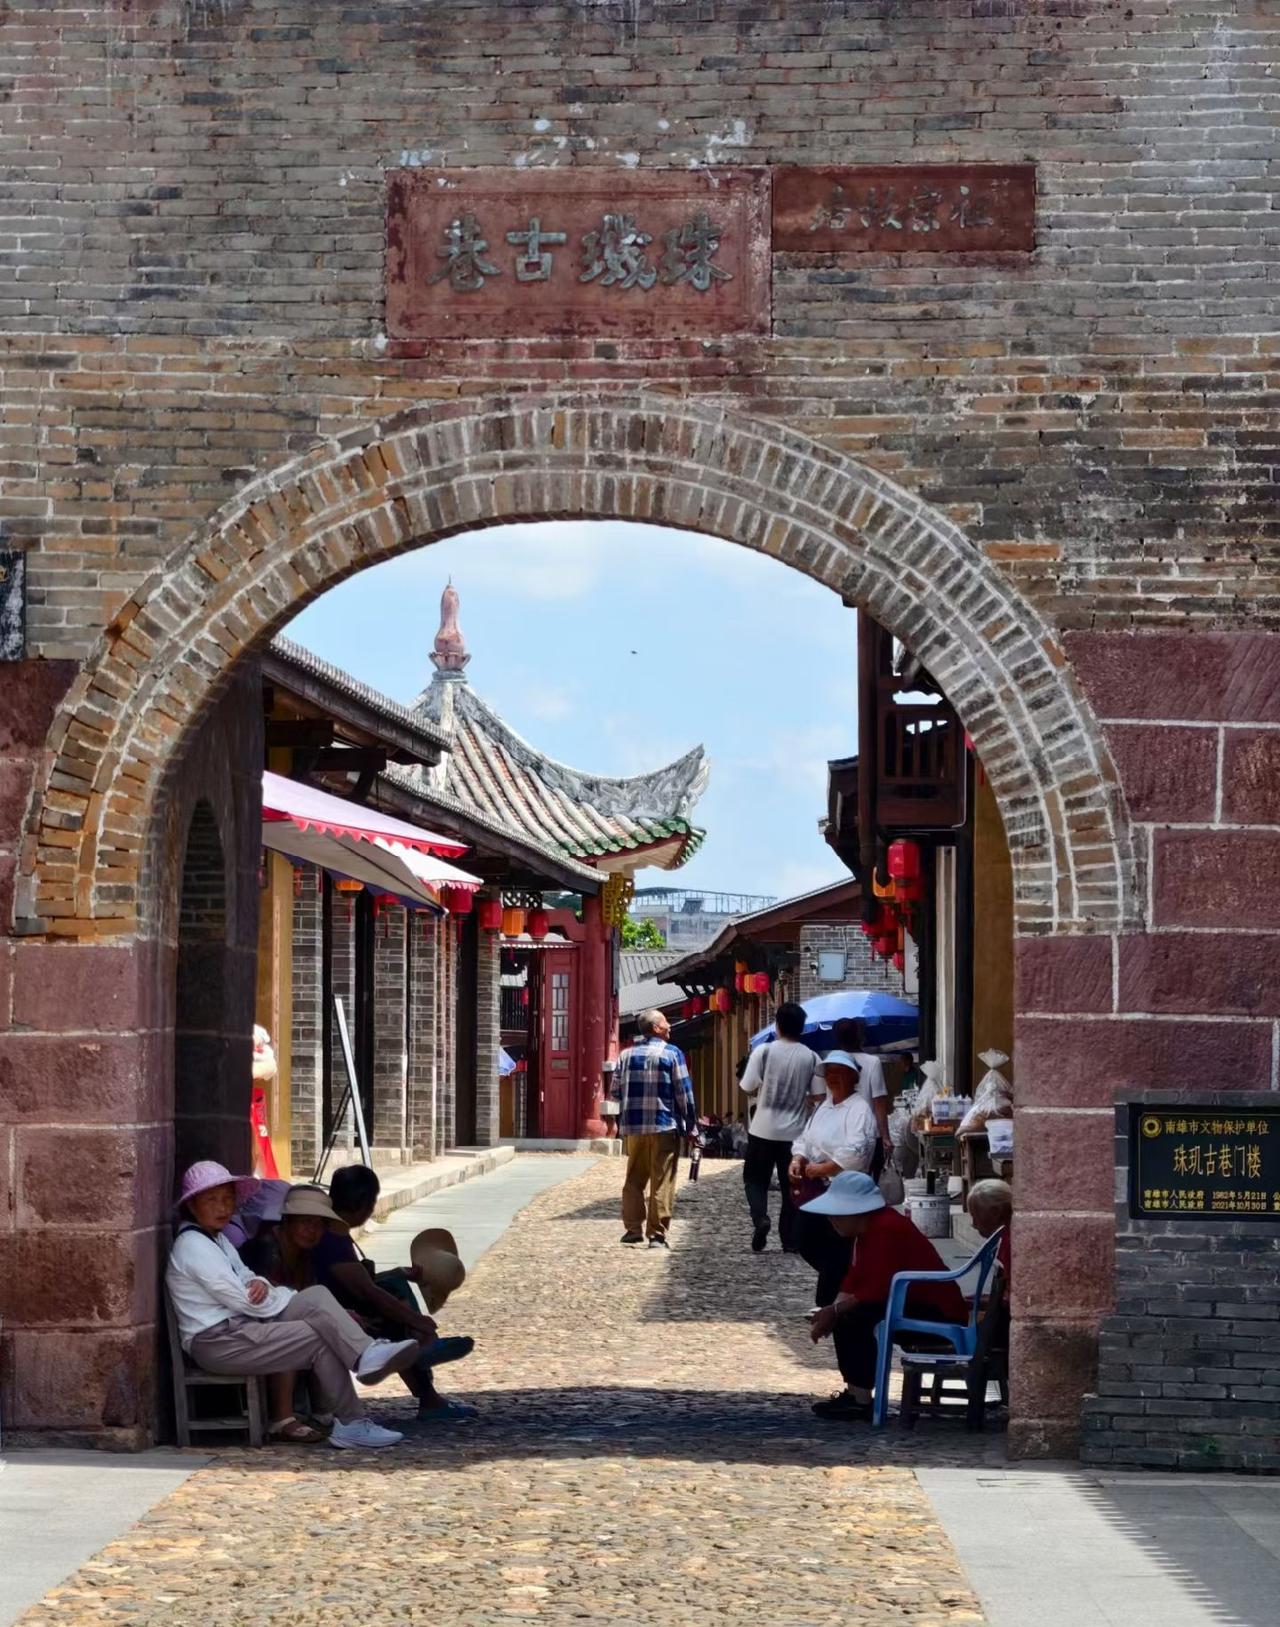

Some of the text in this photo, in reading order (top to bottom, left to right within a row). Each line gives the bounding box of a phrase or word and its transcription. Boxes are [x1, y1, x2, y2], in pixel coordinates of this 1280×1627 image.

[1164, 1119, 1270, 1136] 南雄市文物保护单位
[1173, 1143, 1262, 1179] 珠玑古巷门楼
[1143, 1189, 1205, 1200] 南雄市人民政府
[1143, 1199, 1205, 1210] 南雄市人民政府
